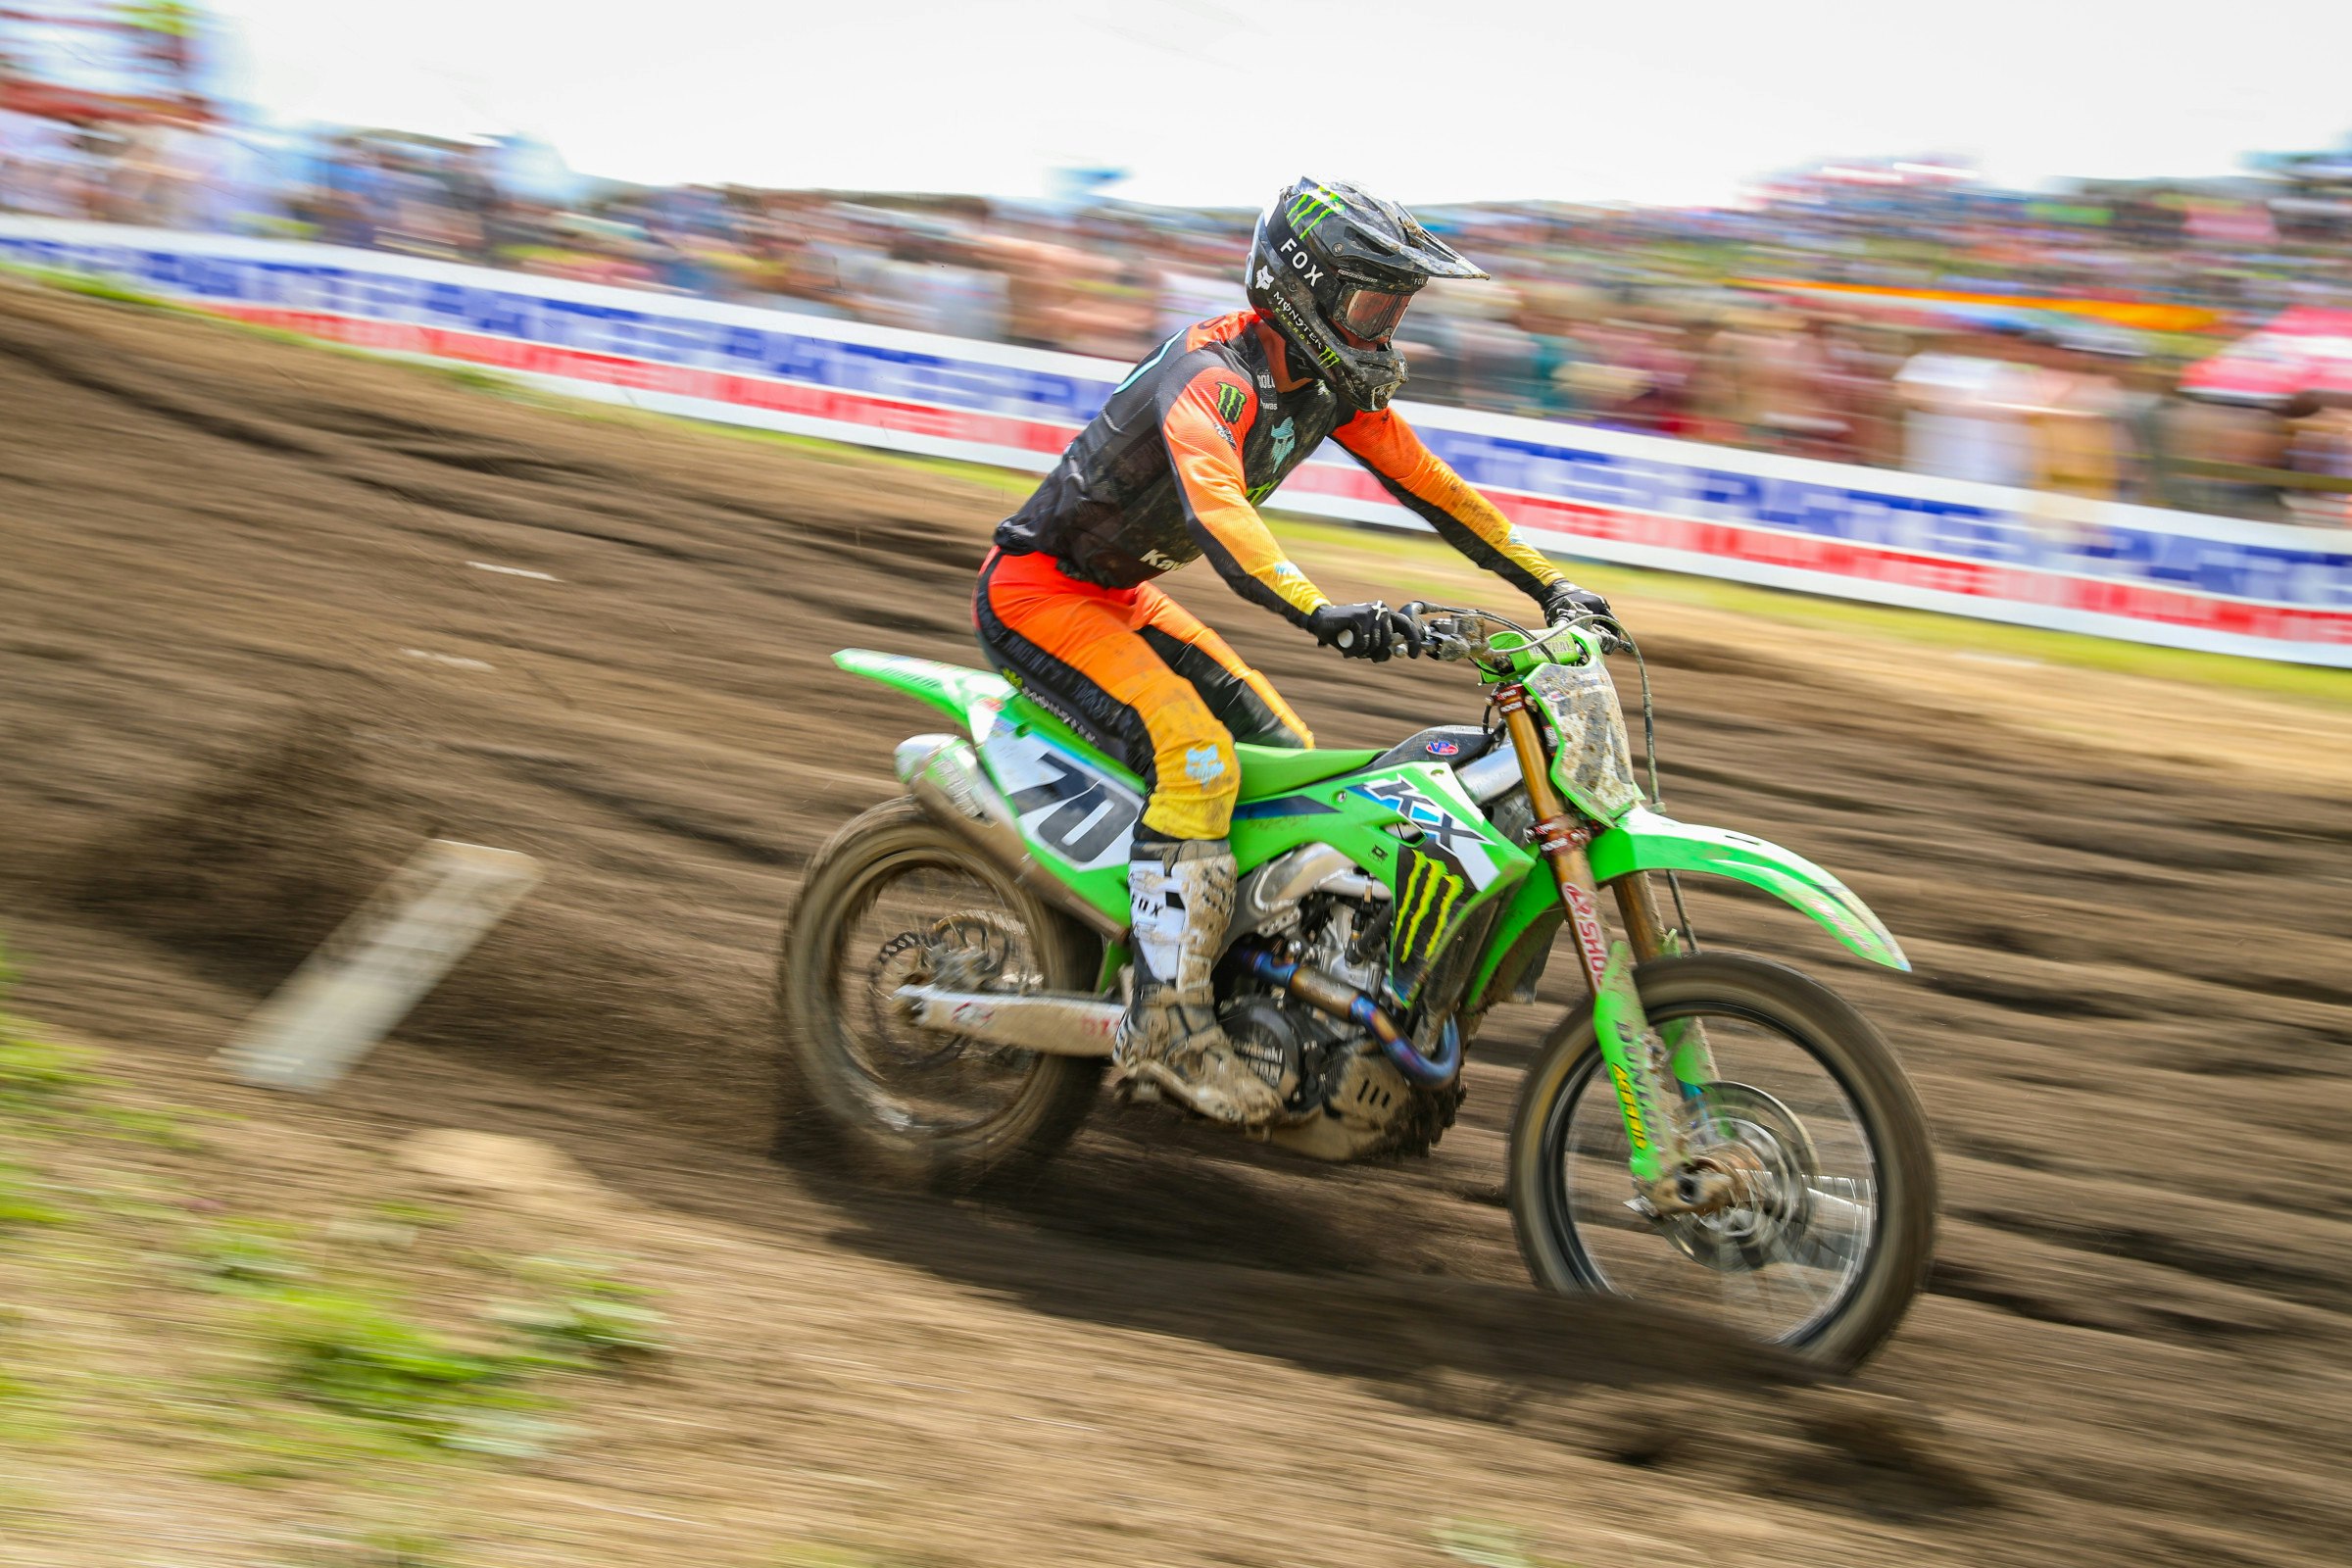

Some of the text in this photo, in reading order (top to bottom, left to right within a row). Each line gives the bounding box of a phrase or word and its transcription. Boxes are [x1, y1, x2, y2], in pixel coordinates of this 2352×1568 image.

[1280, 237, 1325, 287] FOX
[1274, 307, 1311, 345] ENERGY
[1006, 753, 1139, 863] 70
[1363, 773, 1497, 852] KX
